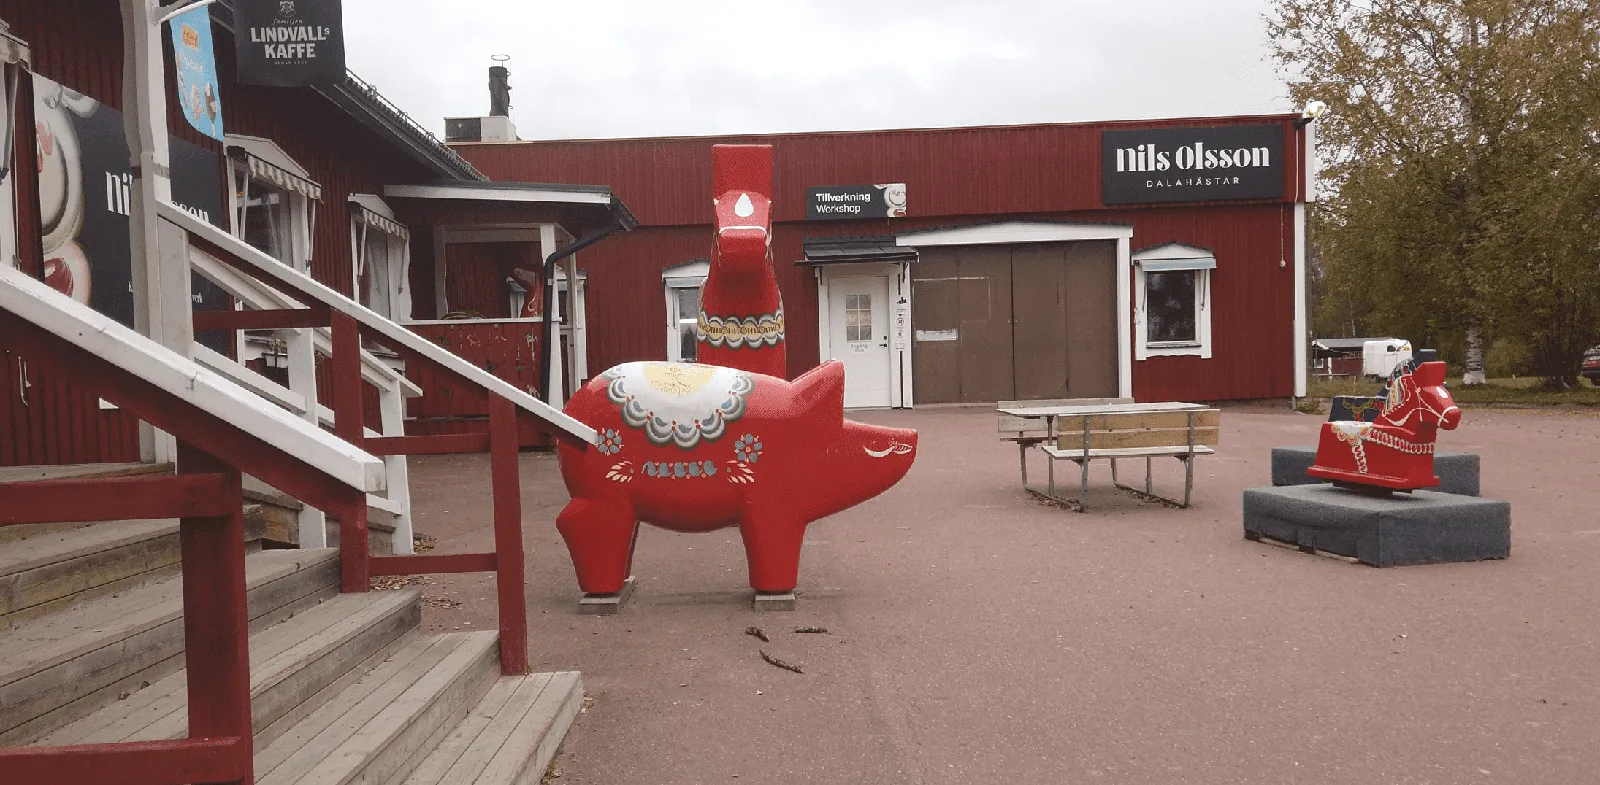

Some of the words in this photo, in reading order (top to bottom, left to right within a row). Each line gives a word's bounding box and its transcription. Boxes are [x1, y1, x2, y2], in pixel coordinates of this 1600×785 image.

[272, 18, 303, 26] familjen
[264, 43, 316, 59] KAFFE
[1175, 142, 1271, 170] Olsson
[1146, 176, 1240, 188] DALAHÄSTAR
[815, 192, 871, 203] Tillverkning
[815, 204, 861, 214] Workshop
